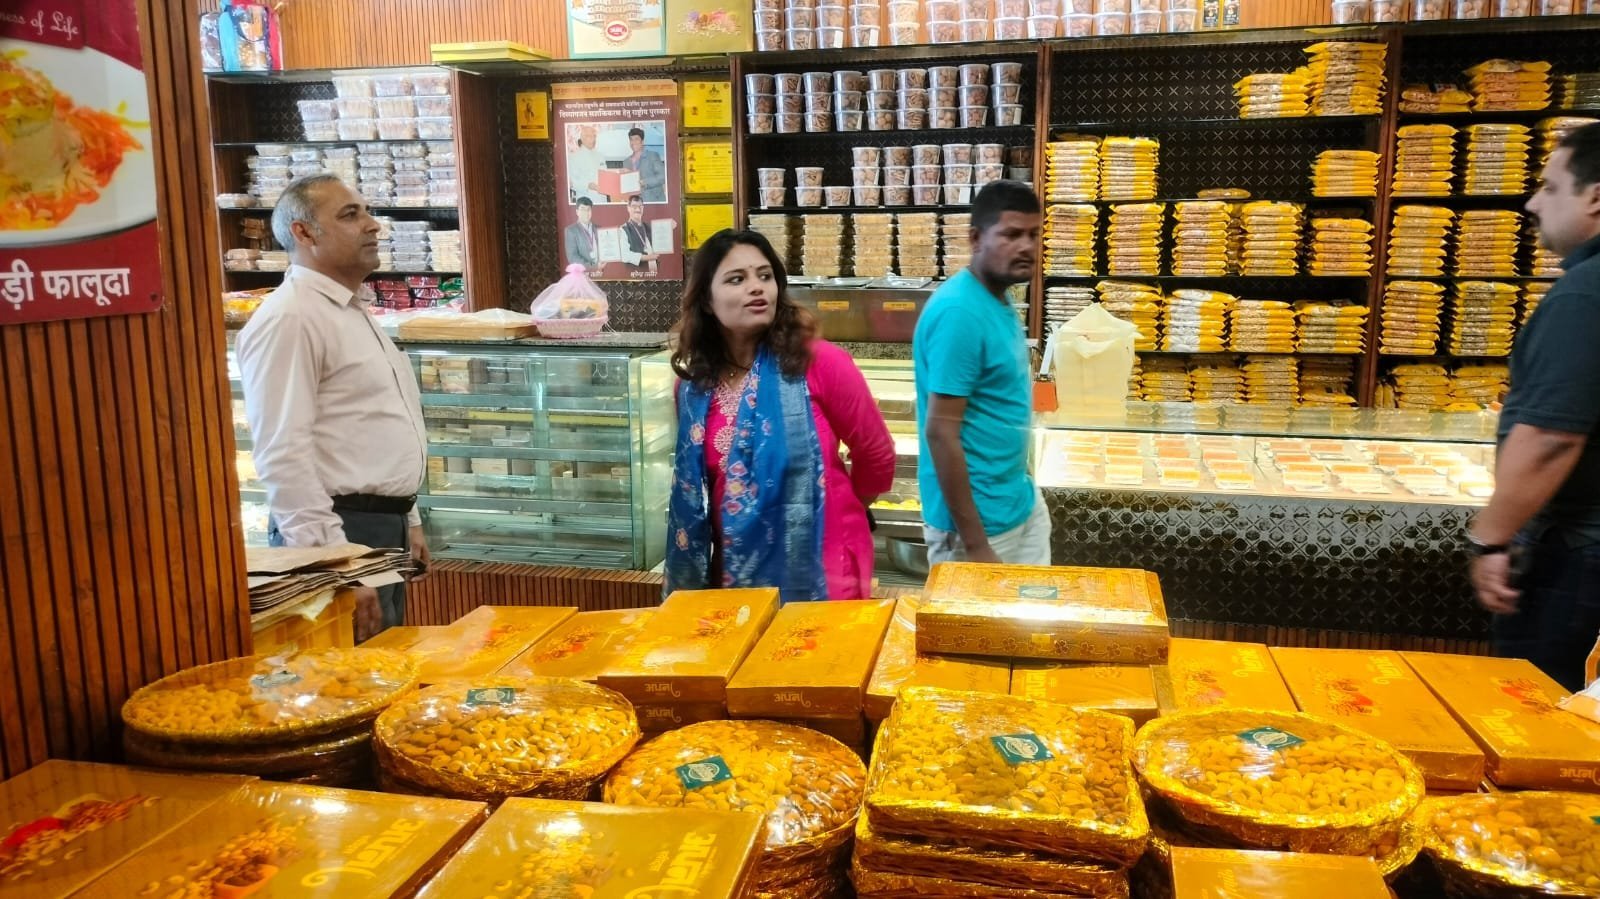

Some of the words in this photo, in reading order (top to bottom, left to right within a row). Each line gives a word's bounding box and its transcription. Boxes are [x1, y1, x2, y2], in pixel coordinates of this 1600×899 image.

[30, 10, 44, 35] of
[50, 11, 79, 41] Life
[622, 108, 632, 119] हेतु
[632, 107, 648, 117] राष्ट्रीय
[41, 268, 130, 305] फालूदा
